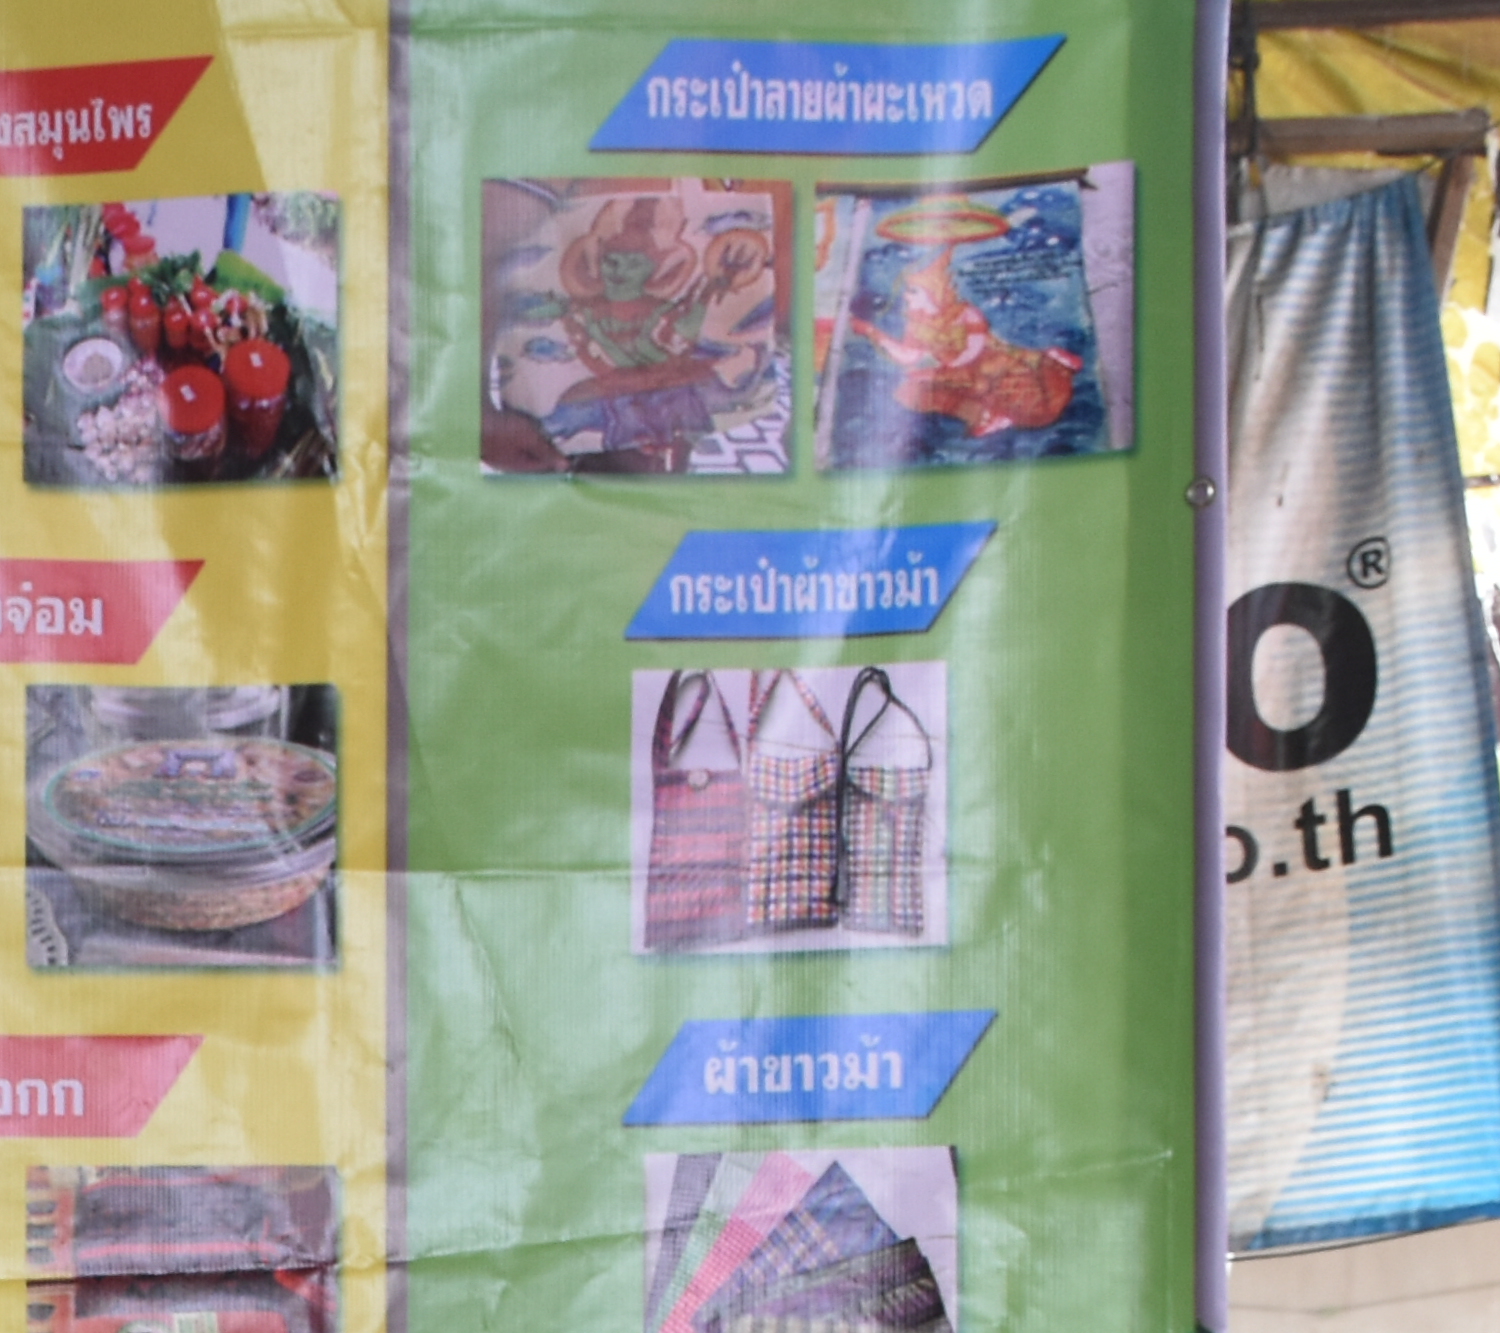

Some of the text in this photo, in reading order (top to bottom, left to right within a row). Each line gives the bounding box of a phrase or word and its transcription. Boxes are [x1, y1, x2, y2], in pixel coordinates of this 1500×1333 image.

[669, 555, 940, 617] กระเป๋าผ้าขาวม้า
[703, 1035, 904, 1098] ผ้าขาวม้า
